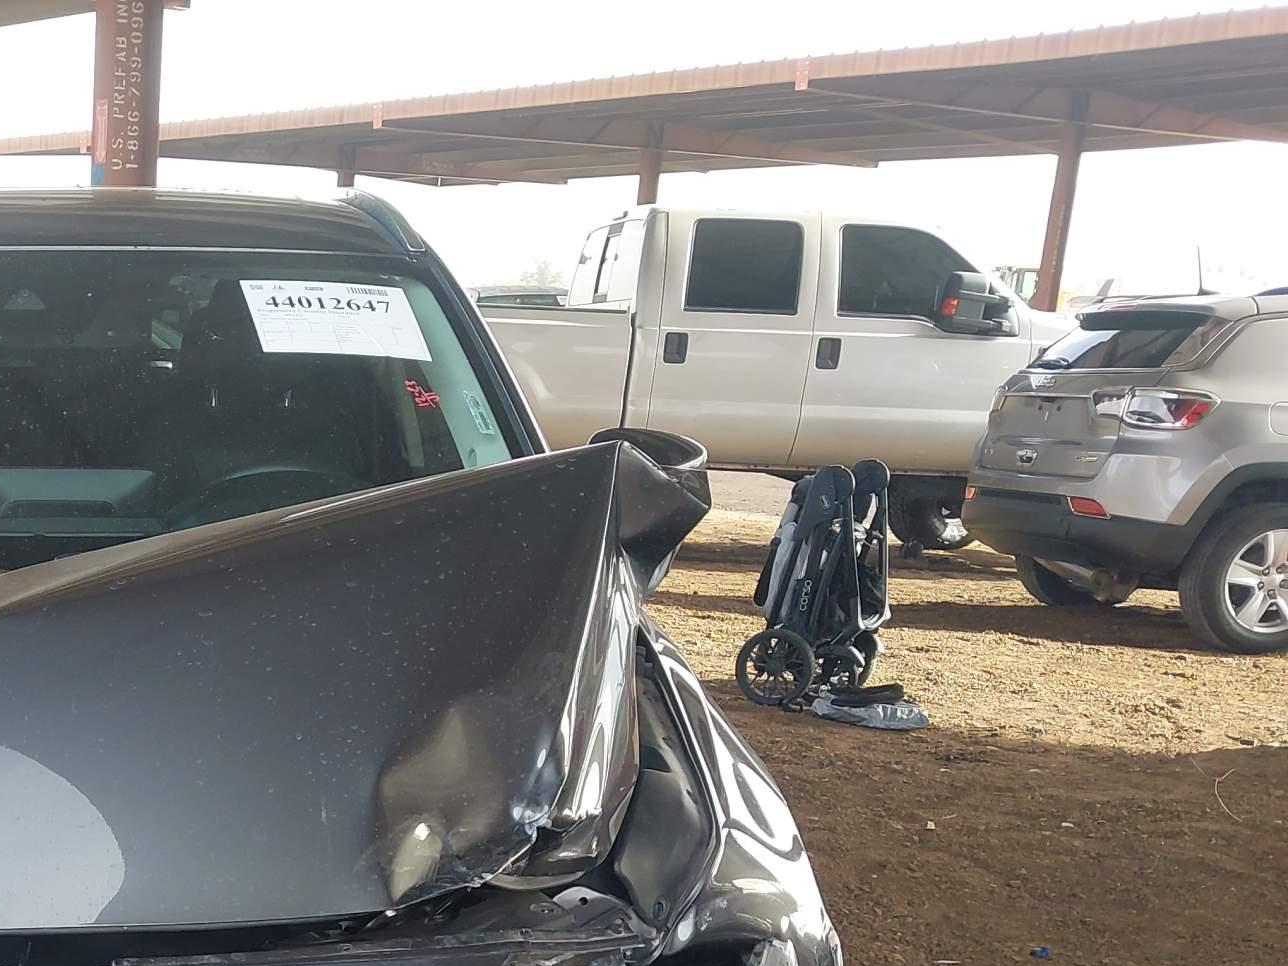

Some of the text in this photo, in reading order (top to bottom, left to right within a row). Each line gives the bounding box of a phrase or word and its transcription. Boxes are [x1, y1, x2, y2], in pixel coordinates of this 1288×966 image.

[111, 0, 129, 170] U.S. PREFAB IN
[265, 295, 391, 314] 44012647
[799, 579, 813, 611] corso
